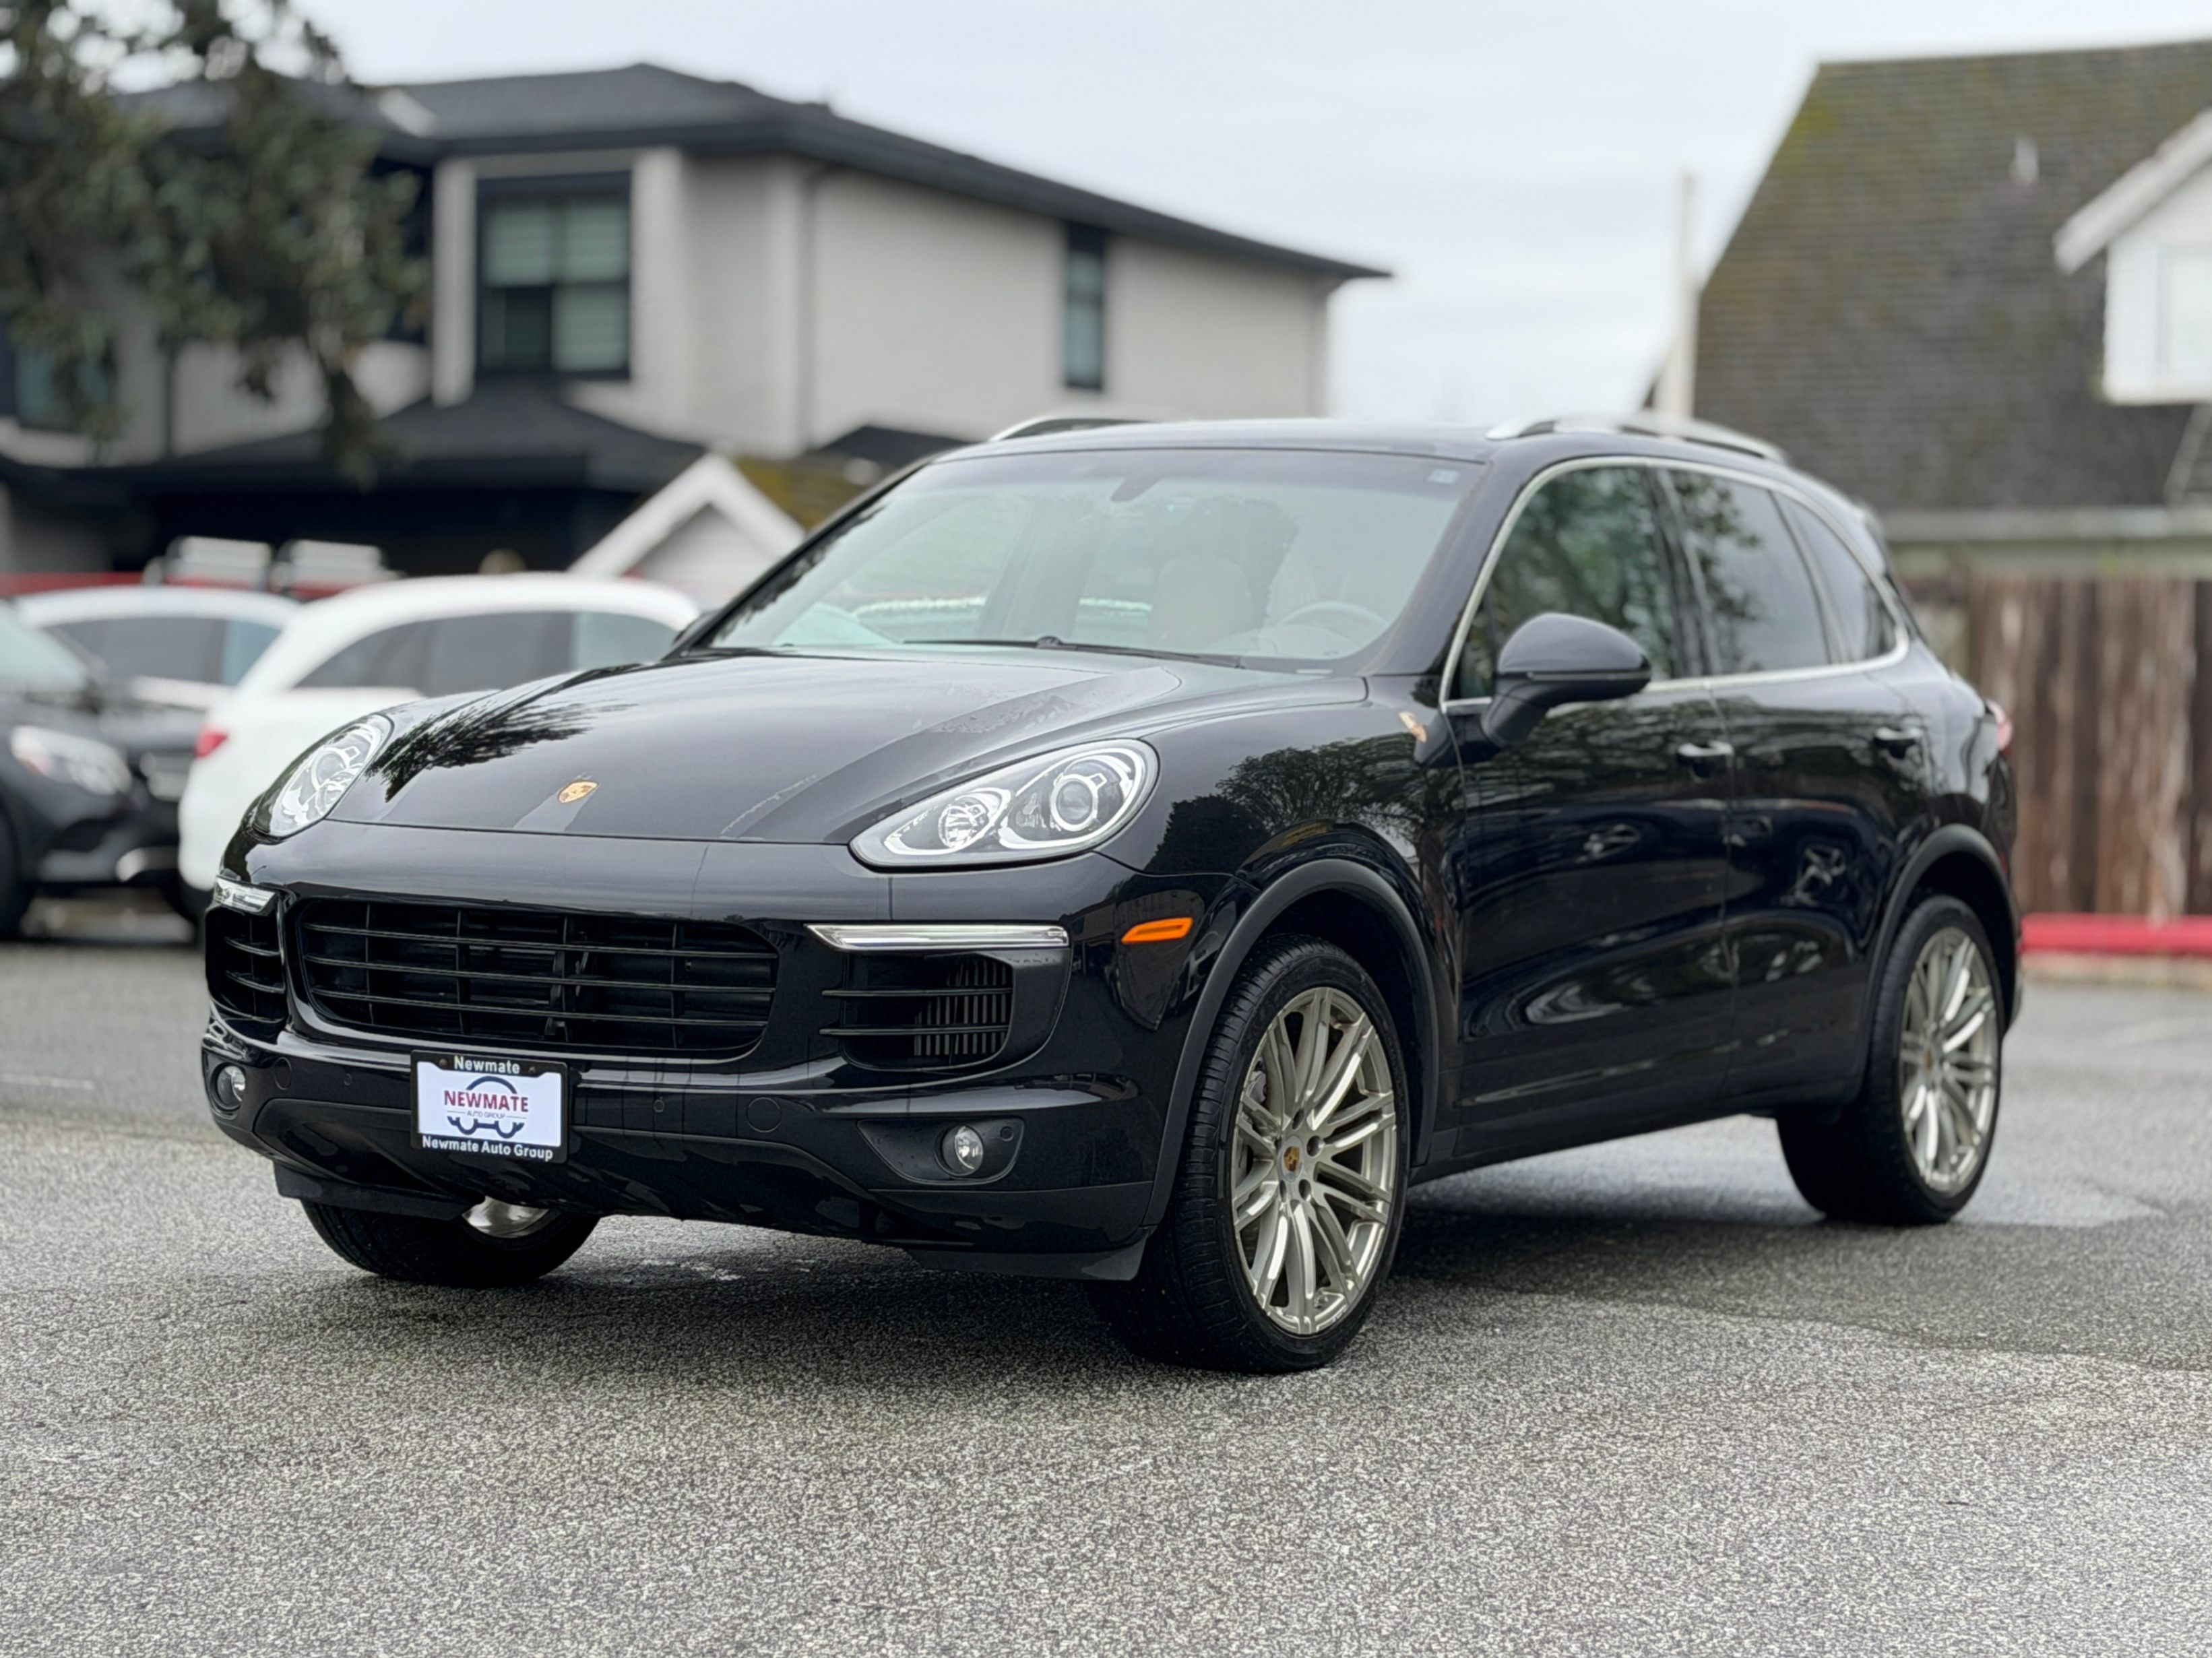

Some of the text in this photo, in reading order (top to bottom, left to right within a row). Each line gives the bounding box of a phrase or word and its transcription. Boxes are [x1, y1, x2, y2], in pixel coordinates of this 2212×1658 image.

[453, 1055, 521, 1075] Newmate
[443, 1090, 529, 1112] NEWMATE
[466, 1110, 483, 1118] AUTO
[422, 1135, 553, 1162] Newmate Auto Group
